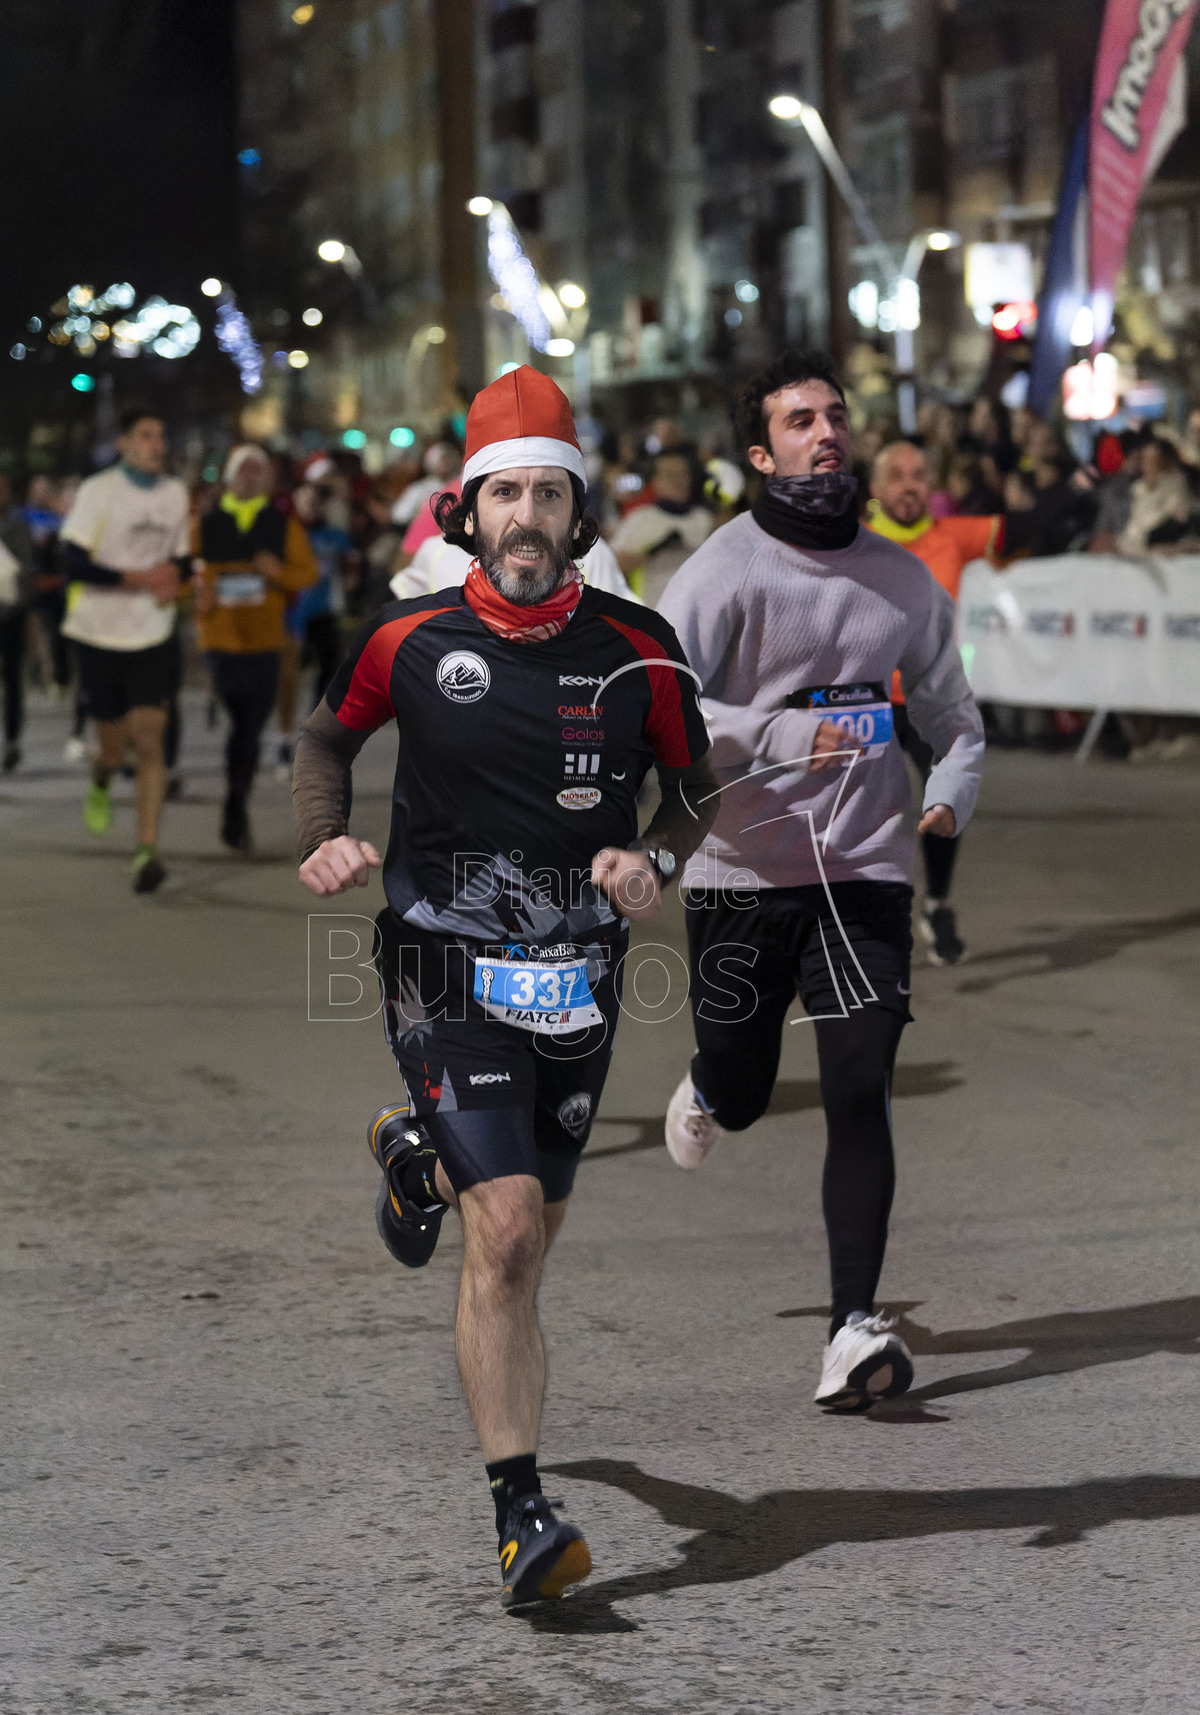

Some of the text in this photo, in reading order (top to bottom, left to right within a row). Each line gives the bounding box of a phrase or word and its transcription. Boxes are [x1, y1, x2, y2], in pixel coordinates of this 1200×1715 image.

[557, 704, 604, 717] CARLIN
[511, 971, 577, 1007] 337
[505, 1008, 560, 1024] FIATC
